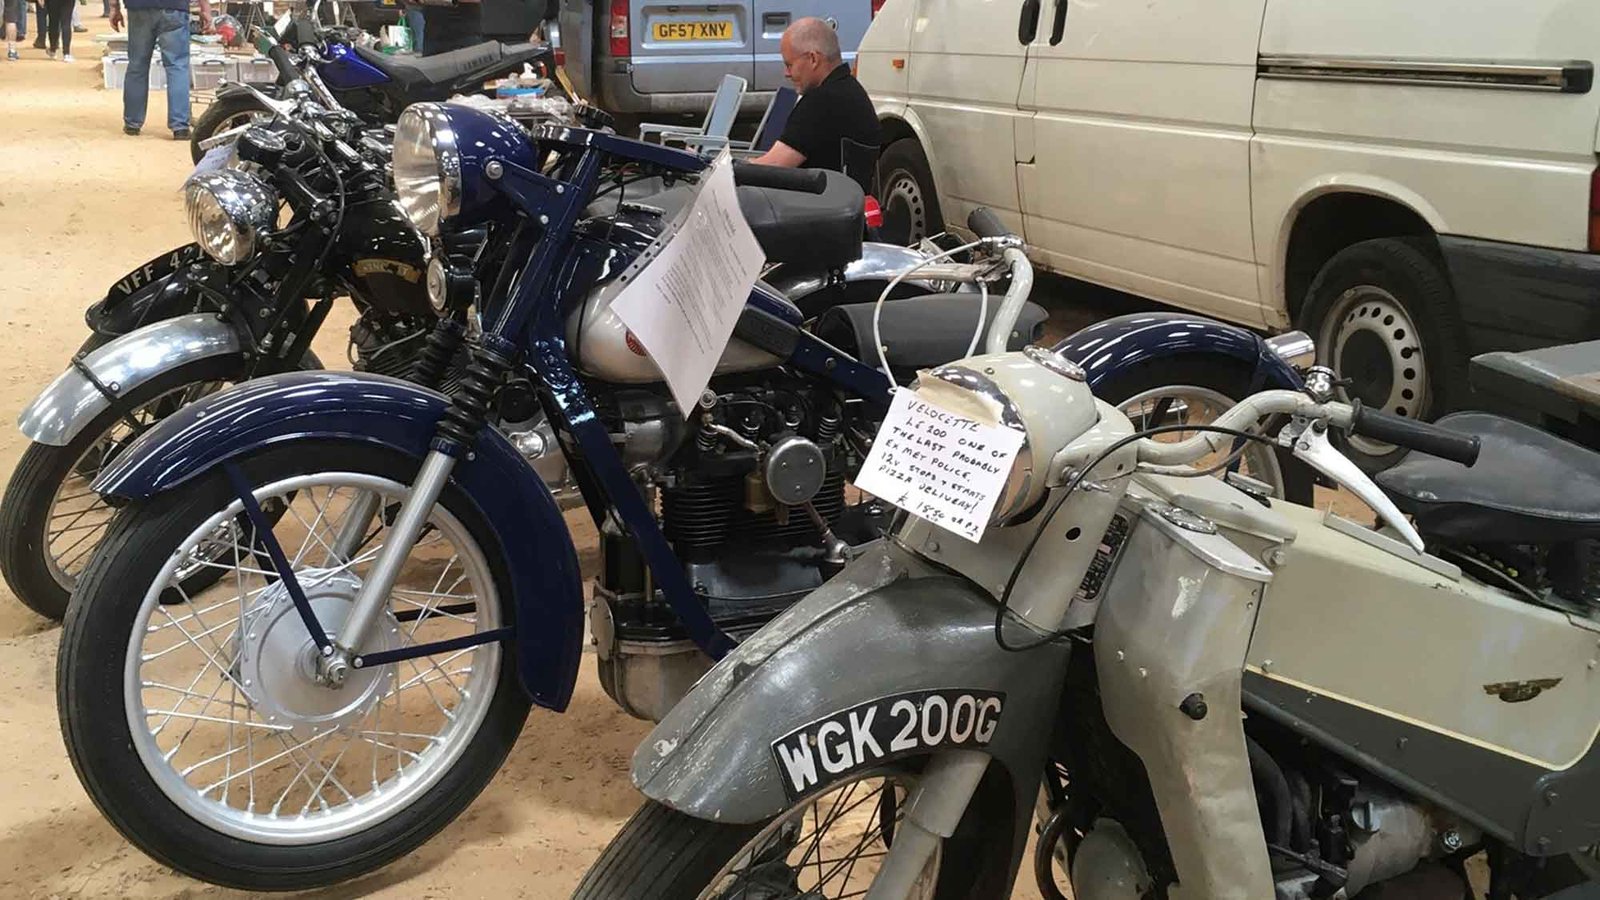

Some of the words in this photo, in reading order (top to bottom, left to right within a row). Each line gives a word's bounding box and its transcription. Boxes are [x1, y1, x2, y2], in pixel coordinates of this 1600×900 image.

[659, 23, 696, 38] GF57
[700, 23, 727, 37] XNY
[117, 264, 154, 295] VFF
[907, 400, 980, 432] VELOCETTE
[885, 439, 899, 450] EX
[902, 447, 927, 460] MET
[893, 426, 914, 440] THE
[916, 437, 946, 452] LAST
[952, 450, 1000, 474] PROBABLY
[926, 424, 947, 438] 200
[958, 438, 986, 451] ONE
[991, 450, 1008, 458] OF
[878, 464, 912, 483] PIZZA
[918, 483, 979, 514] DELIVERY!
[909, 465, 936, 480] STOPS
[951, 483, 986, 501] STARTS
[777, 705, 884, 793] WGK
[890, 694, 1001, 752] 200G
